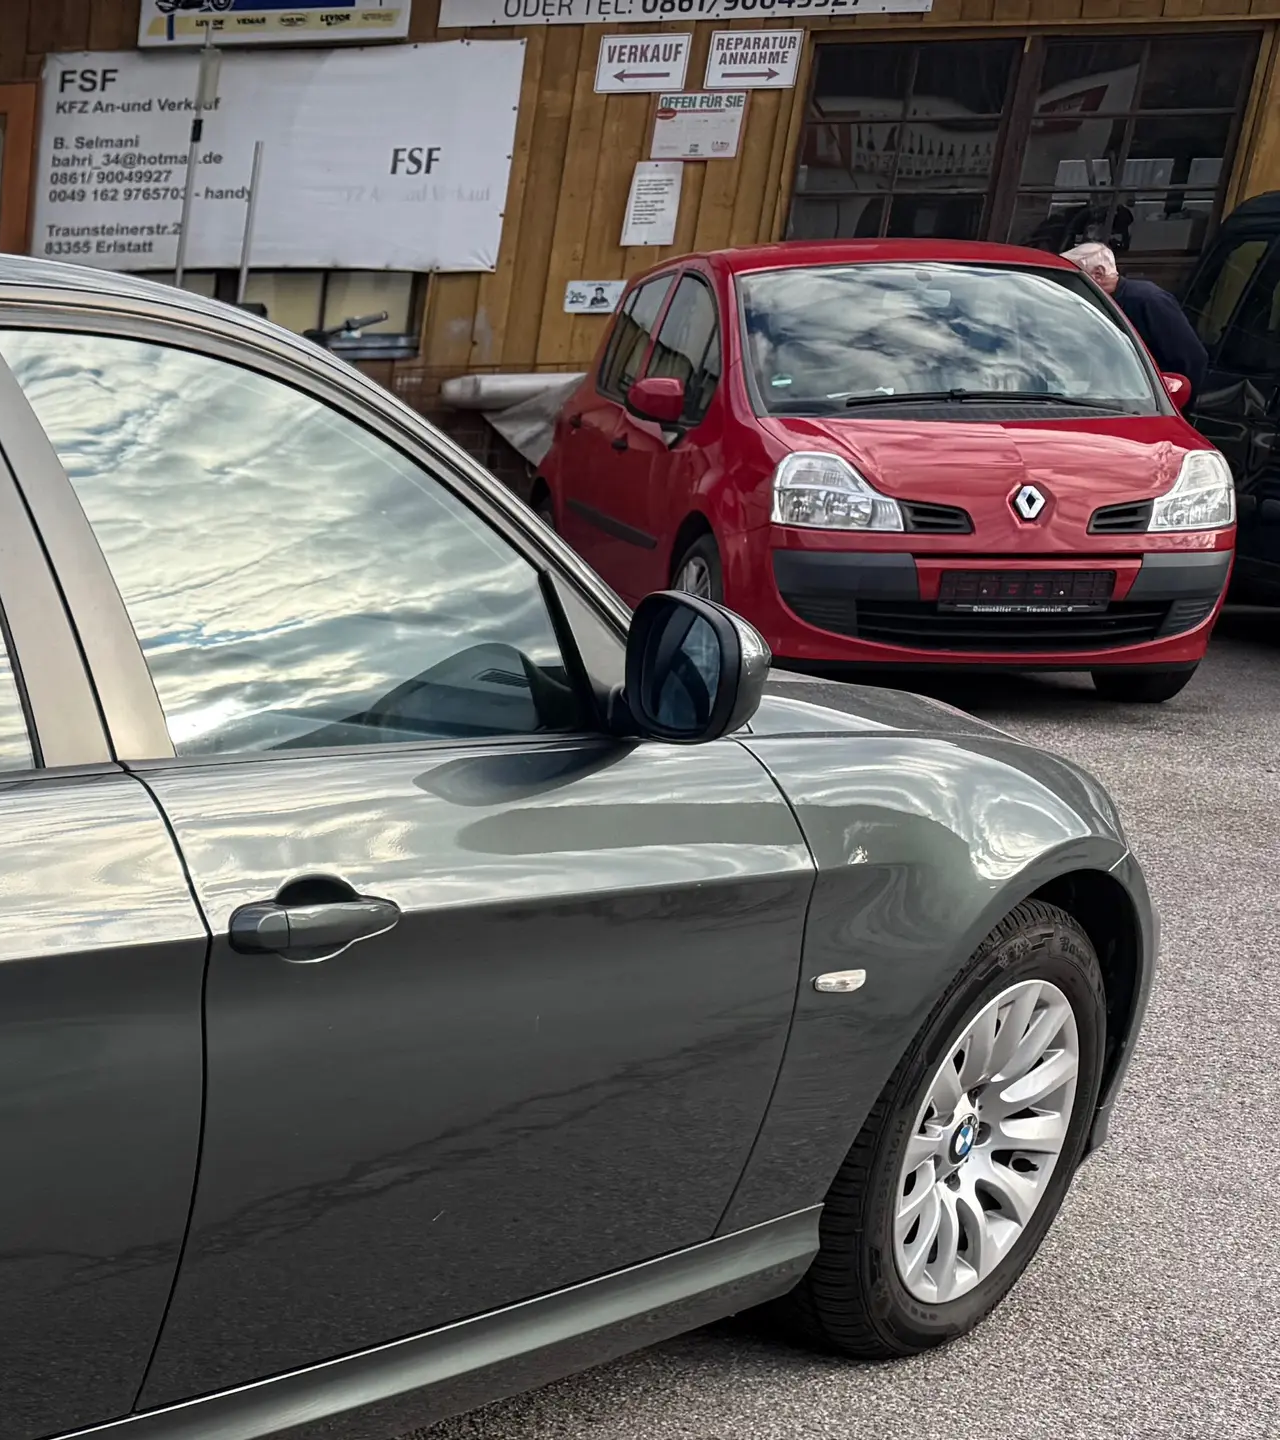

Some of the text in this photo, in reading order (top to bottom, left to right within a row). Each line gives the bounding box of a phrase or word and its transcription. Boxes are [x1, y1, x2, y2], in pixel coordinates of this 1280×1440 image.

[716, 36, 797, 51] REPARATUR
[607, 43, 683, 63] VERKAUF
[718, 51, 789, 65] ANNAHME
[58, 69, 119, 93] FSF
[55, 98, 221, 114] KFZ An-und Verkuf
[660, 94, 745, 109] OFFEN FÜR SIE
[53, 135, 140, 150] B. Selmani
[51, 151, 223, 169] bahri_34@hotma.de
[390, 147, 442, 175] FSF
[50, 170, 172, 185] 0861/ 90049927
[48, 189, 86, 203] 0049
[92, 188, 119, 202] 162
[204, 186, 252, 203] handy
[95, 240, 154, 254] Erlstatt
